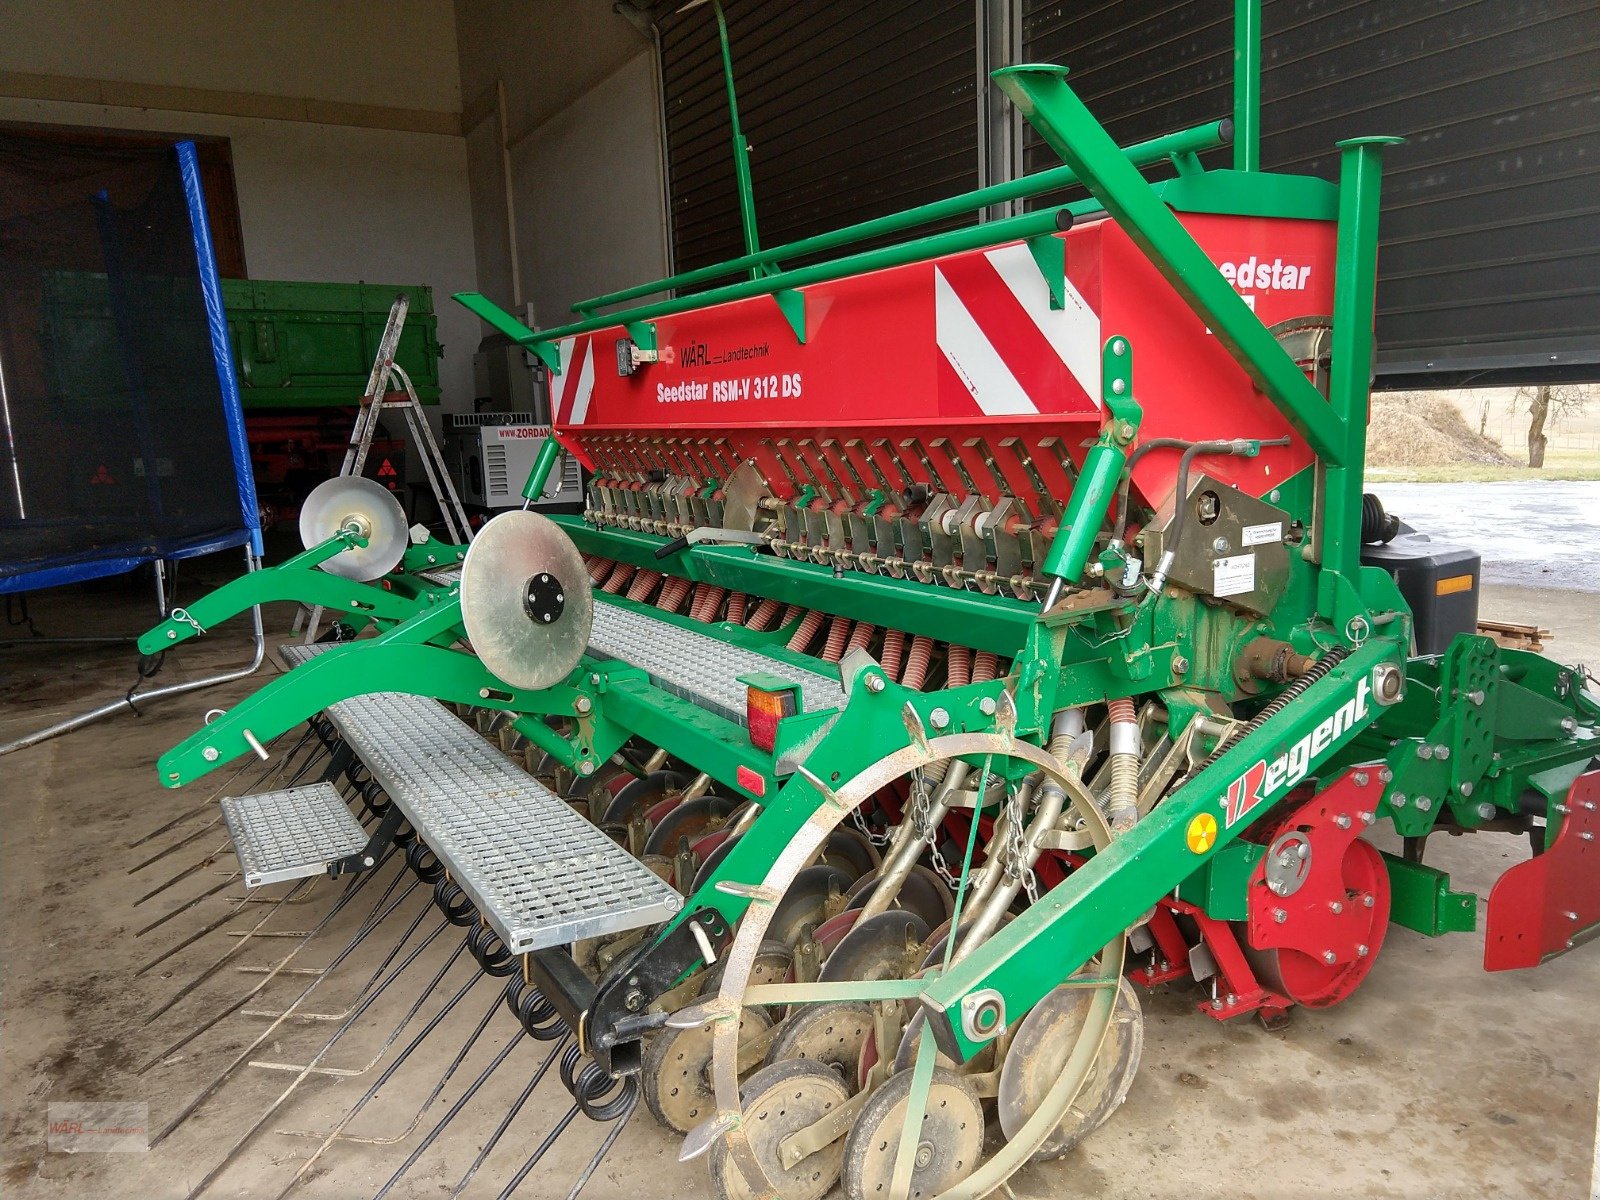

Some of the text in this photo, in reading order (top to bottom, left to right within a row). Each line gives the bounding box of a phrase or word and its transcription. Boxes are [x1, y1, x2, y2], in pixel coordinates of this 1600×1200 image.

[1219, 256, 1311, 290] edstar
[680, 340, 711, 368] WÄRL
[657, 373, 802, 402] Seedstar RSM-V 312 DS
[1226, 675, 1371, 830] Regent
